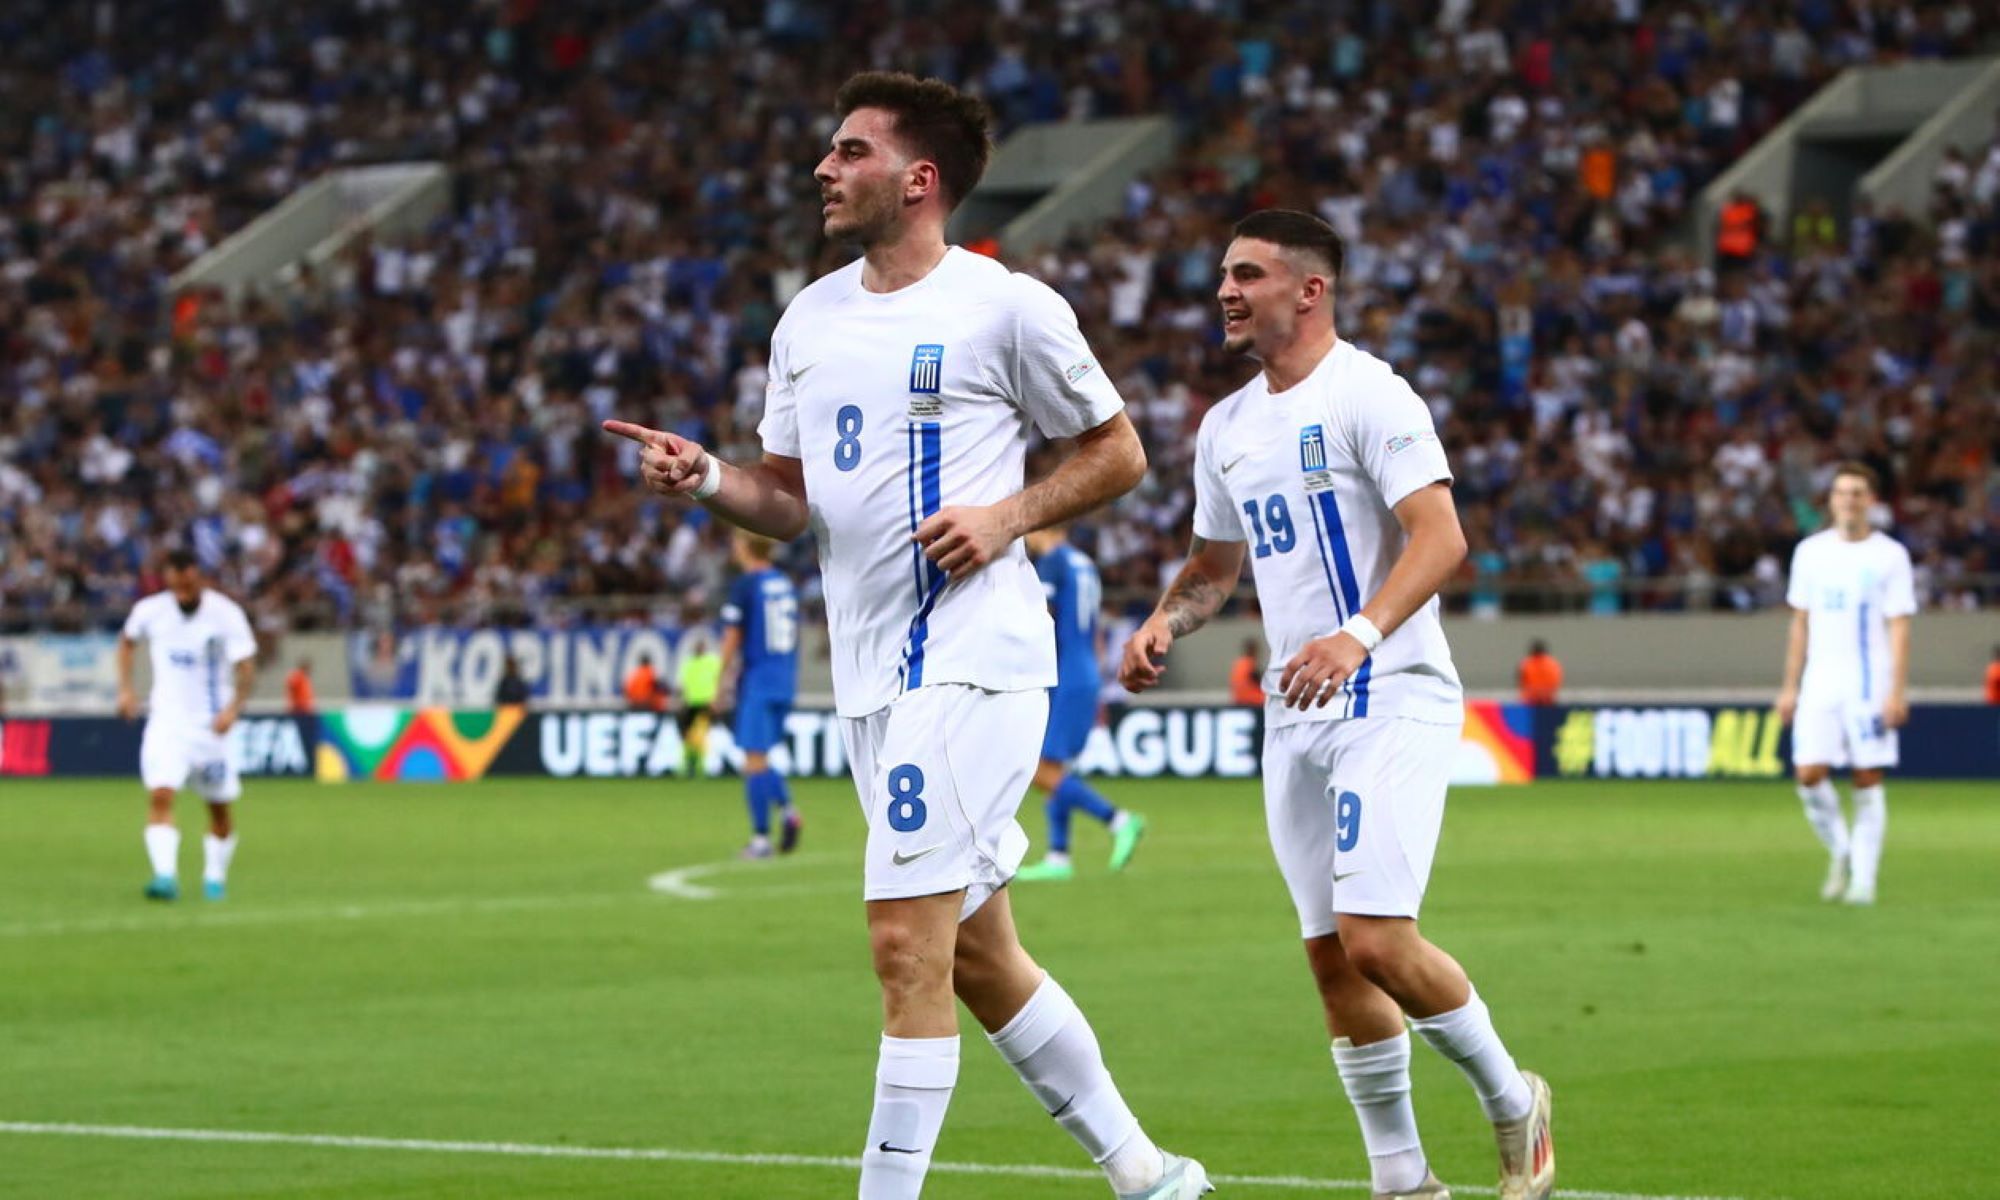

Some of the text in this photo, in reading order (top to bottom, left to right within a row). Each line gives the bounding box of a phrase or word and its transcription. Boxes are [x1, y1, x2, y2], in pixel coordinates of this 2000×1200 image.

[834, 404, 863, 471] 8
[1242, 493, 1296, 559] 19
[238, 718, 308, 773] EFA
[541, 713, 686, 776] UEFA
[1073, 708, 1258, 777] AGUE
[887, 763, 928, 832] 8
[1335, 790, 1362, 853] 9
